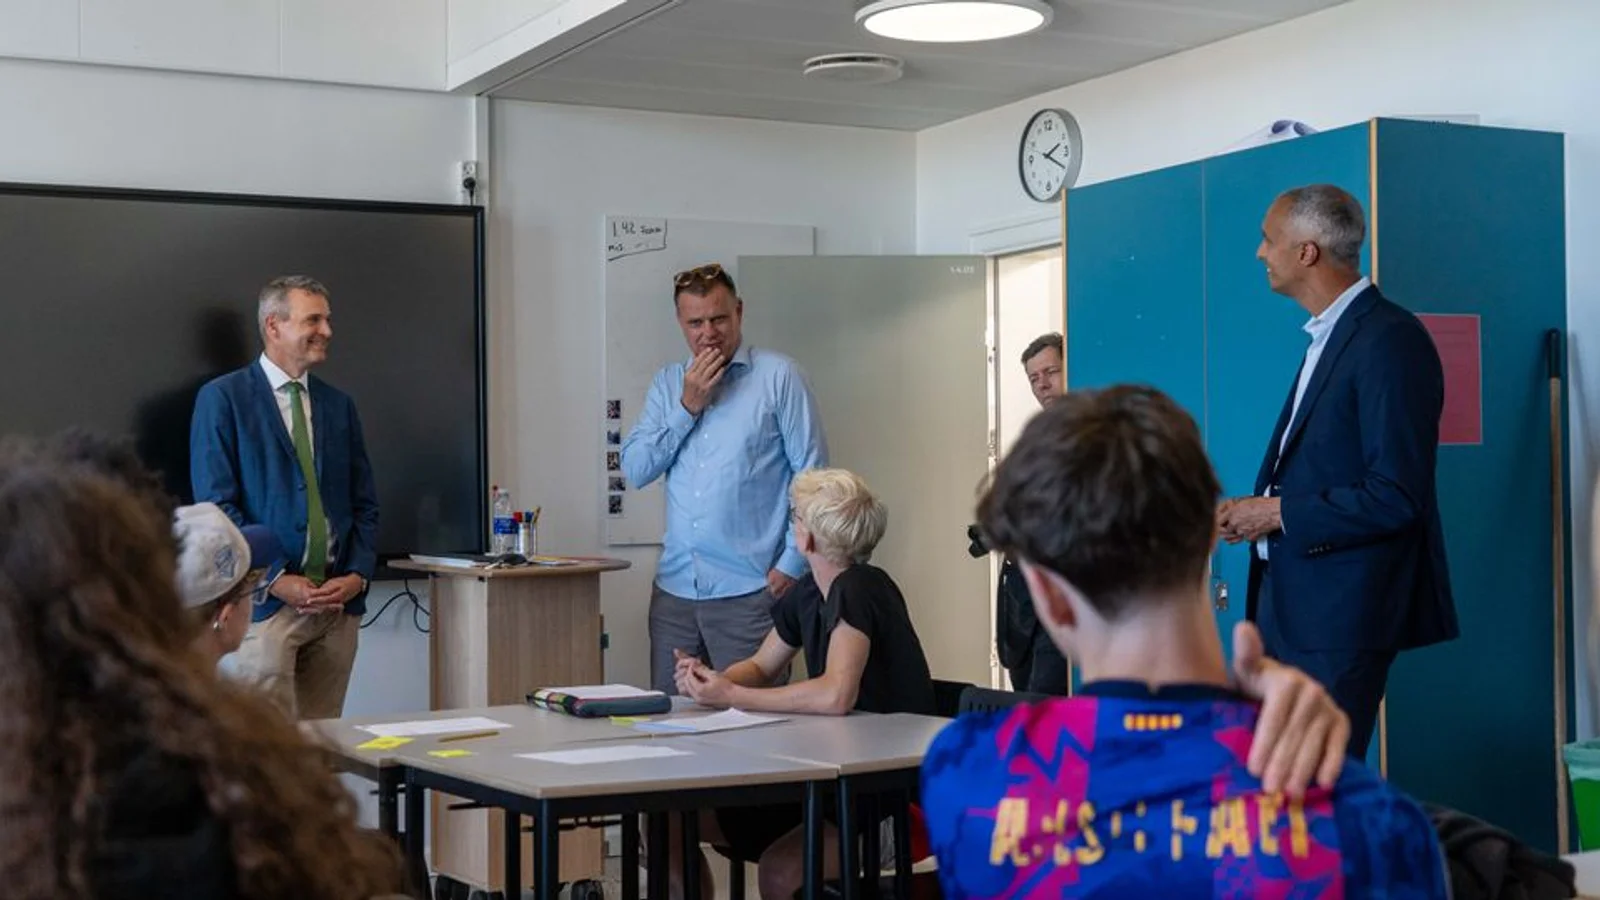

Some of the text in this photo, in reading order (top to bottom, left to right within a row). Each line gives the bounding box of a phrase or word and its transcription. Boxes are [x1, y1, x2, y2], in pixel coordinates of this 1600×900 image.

[1043, 119, 1053, 131] 12
[1028, 154, 1035, 165] 9
[1045, 180, 1052, 192] 6
